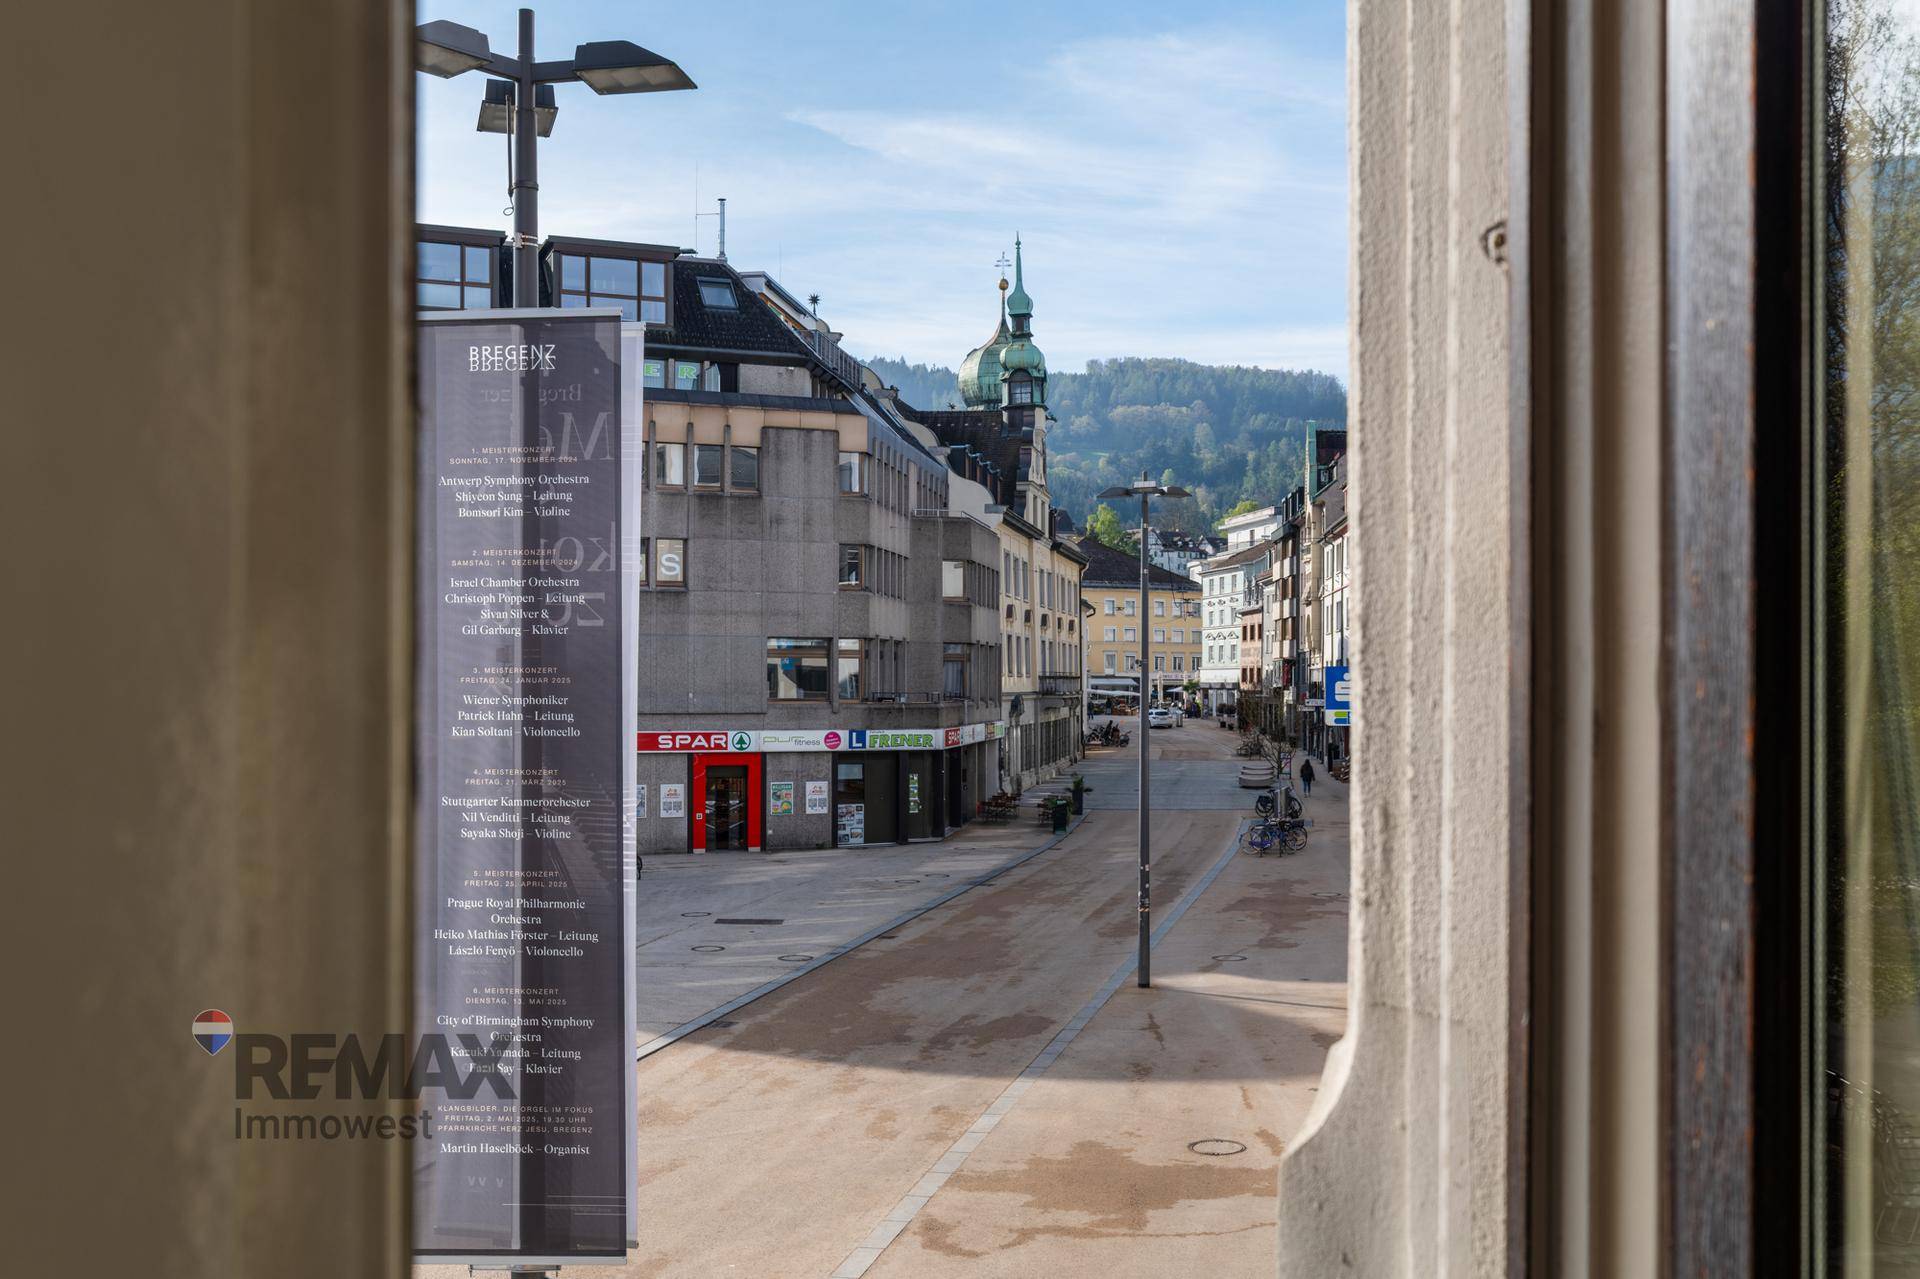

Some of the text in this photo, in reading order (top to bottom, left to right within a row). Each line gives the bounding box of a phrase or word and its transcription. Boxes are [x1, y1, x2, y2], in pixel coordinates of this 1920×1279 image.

[438, 474, 590, 488] Antwerp Symphony Orchestra
[455, 492, 495, 503] Shiyeon
[497, 492, 522, 503] Sung
[533, 491, 573, 501] Leitung
[458, 508, 501, 517] Bomsori
[503, 507, 524, 517] Kim
[535, 507, 570, 516] Violine
[661, 553, 680, 576] S
[450, 577, 579, 588] Israel Chamber Orchestra
[445, 593, 495, 605] Christoph
[498, 594, 534, 605] Poppen
[546, 593, 585, 604] Leitung
[480, 609, 549, 619] Sivan Silver &
[462, 625, 477, 635] Gil
[480, 625, 521, 637] Garburg
[532, 625, 568, 635] Klavier
[463, 694, 569, 707] Wiener Symphoniker
[458, 711, 494, 721] Patrick
[497, 711, 523, 721] Hahn
[535, 711, 575, 722] Leitung
[452, 727, 475, 737] Kian
[477, 726, 513, 737] Soltani
[523, 727, 581, 737] Violoncello
[658, 735, 727, 749] SPAR
[794, 738, 820, 746] fitness
[852, 732, 863, 748] L
[868, 733, 934, 748] FRENER
[521, 777, 545, 786] MÄRZ
[441, 796, 591, 809] Stuttgarter Kammerorchester
[462, 812, 477, 822] Nil
[480, 812, 520, 823] Venditti
[531, 812, 571, 824] Leitung
[461, 828, 496, 840] Sayaka
[499, 828, 524, 841] Shoji
[535, 828, 571, 839] Violine
[485, 870, 559, 878] MEISTERKONZERT
[447, 898, 585, 911] Prague Royal Philharmonic
[491, 914, 542, 924] Orchestra
[434, 930, 464, 939] Heiko
[467, 930, 508, 940] Mathias
[511, 930, 548, 941] Förster
[559, 931, 599, 942] Leitung
[449, 945, 482, 956] László
[526, 946, 583, 957] Violoncello
[437, 1015, 595, 1028] City of Birmingham Symphony
[490, 1032, 542, 1042] Orchestra
[450, 1047, 487, 1057] Kazuki
[490, 1048, 530, 1058] Yamada
[541, 1048, 581, 1060] Leitung
[497, 1064, 513, 1076] Say
[525, 1064, 563, 1074] Klavier
[565, 1106, 593, 1114] FOKUS
[437, 1125, 497, 1133] PFARRKIRCHE
[525, 1126, 551, 1134] JESU,
[553, 1126, 593, 1134] BREGENZ
[440, 1143, 477, 1153] Martin
[480, 1143, 533, 1154] Haselböck
[544, 1144, 590, 1156] Organist
